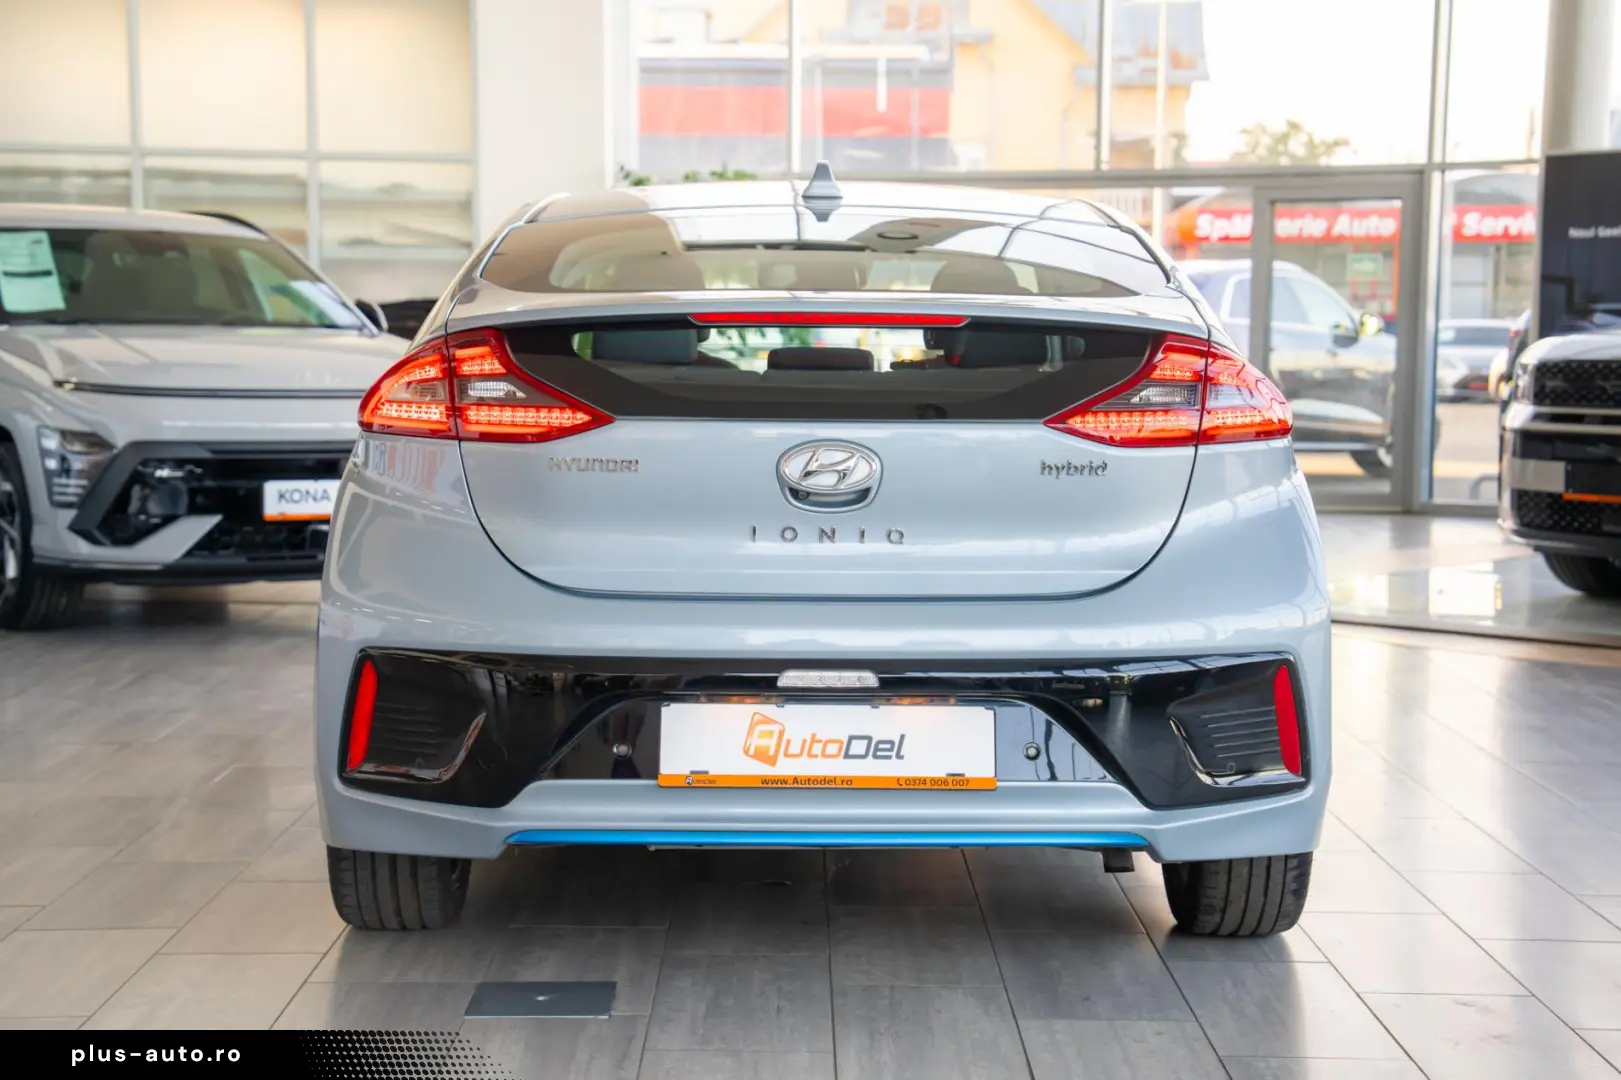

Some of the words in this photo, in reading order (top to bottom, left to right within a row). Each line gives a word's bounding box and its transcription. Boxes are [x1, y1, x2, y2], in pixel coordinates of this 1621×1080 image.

[1331, 212, 1396, 237] Auto
[549, 457, 639, 472] HYUNDAI
[1040, 459, 1108, 479] hybrid
[277, 488, 332, 504] KONA
[750, 525, 905, 545] IONIQ
[745, 720, 907, 761] AutoDel
[760, 776, 853, 787] www.Autodel.ro
[904, 778, 927, 787] 0374
[929, 778, 949, 787] 006
[951, 778, 970, 787] 007
